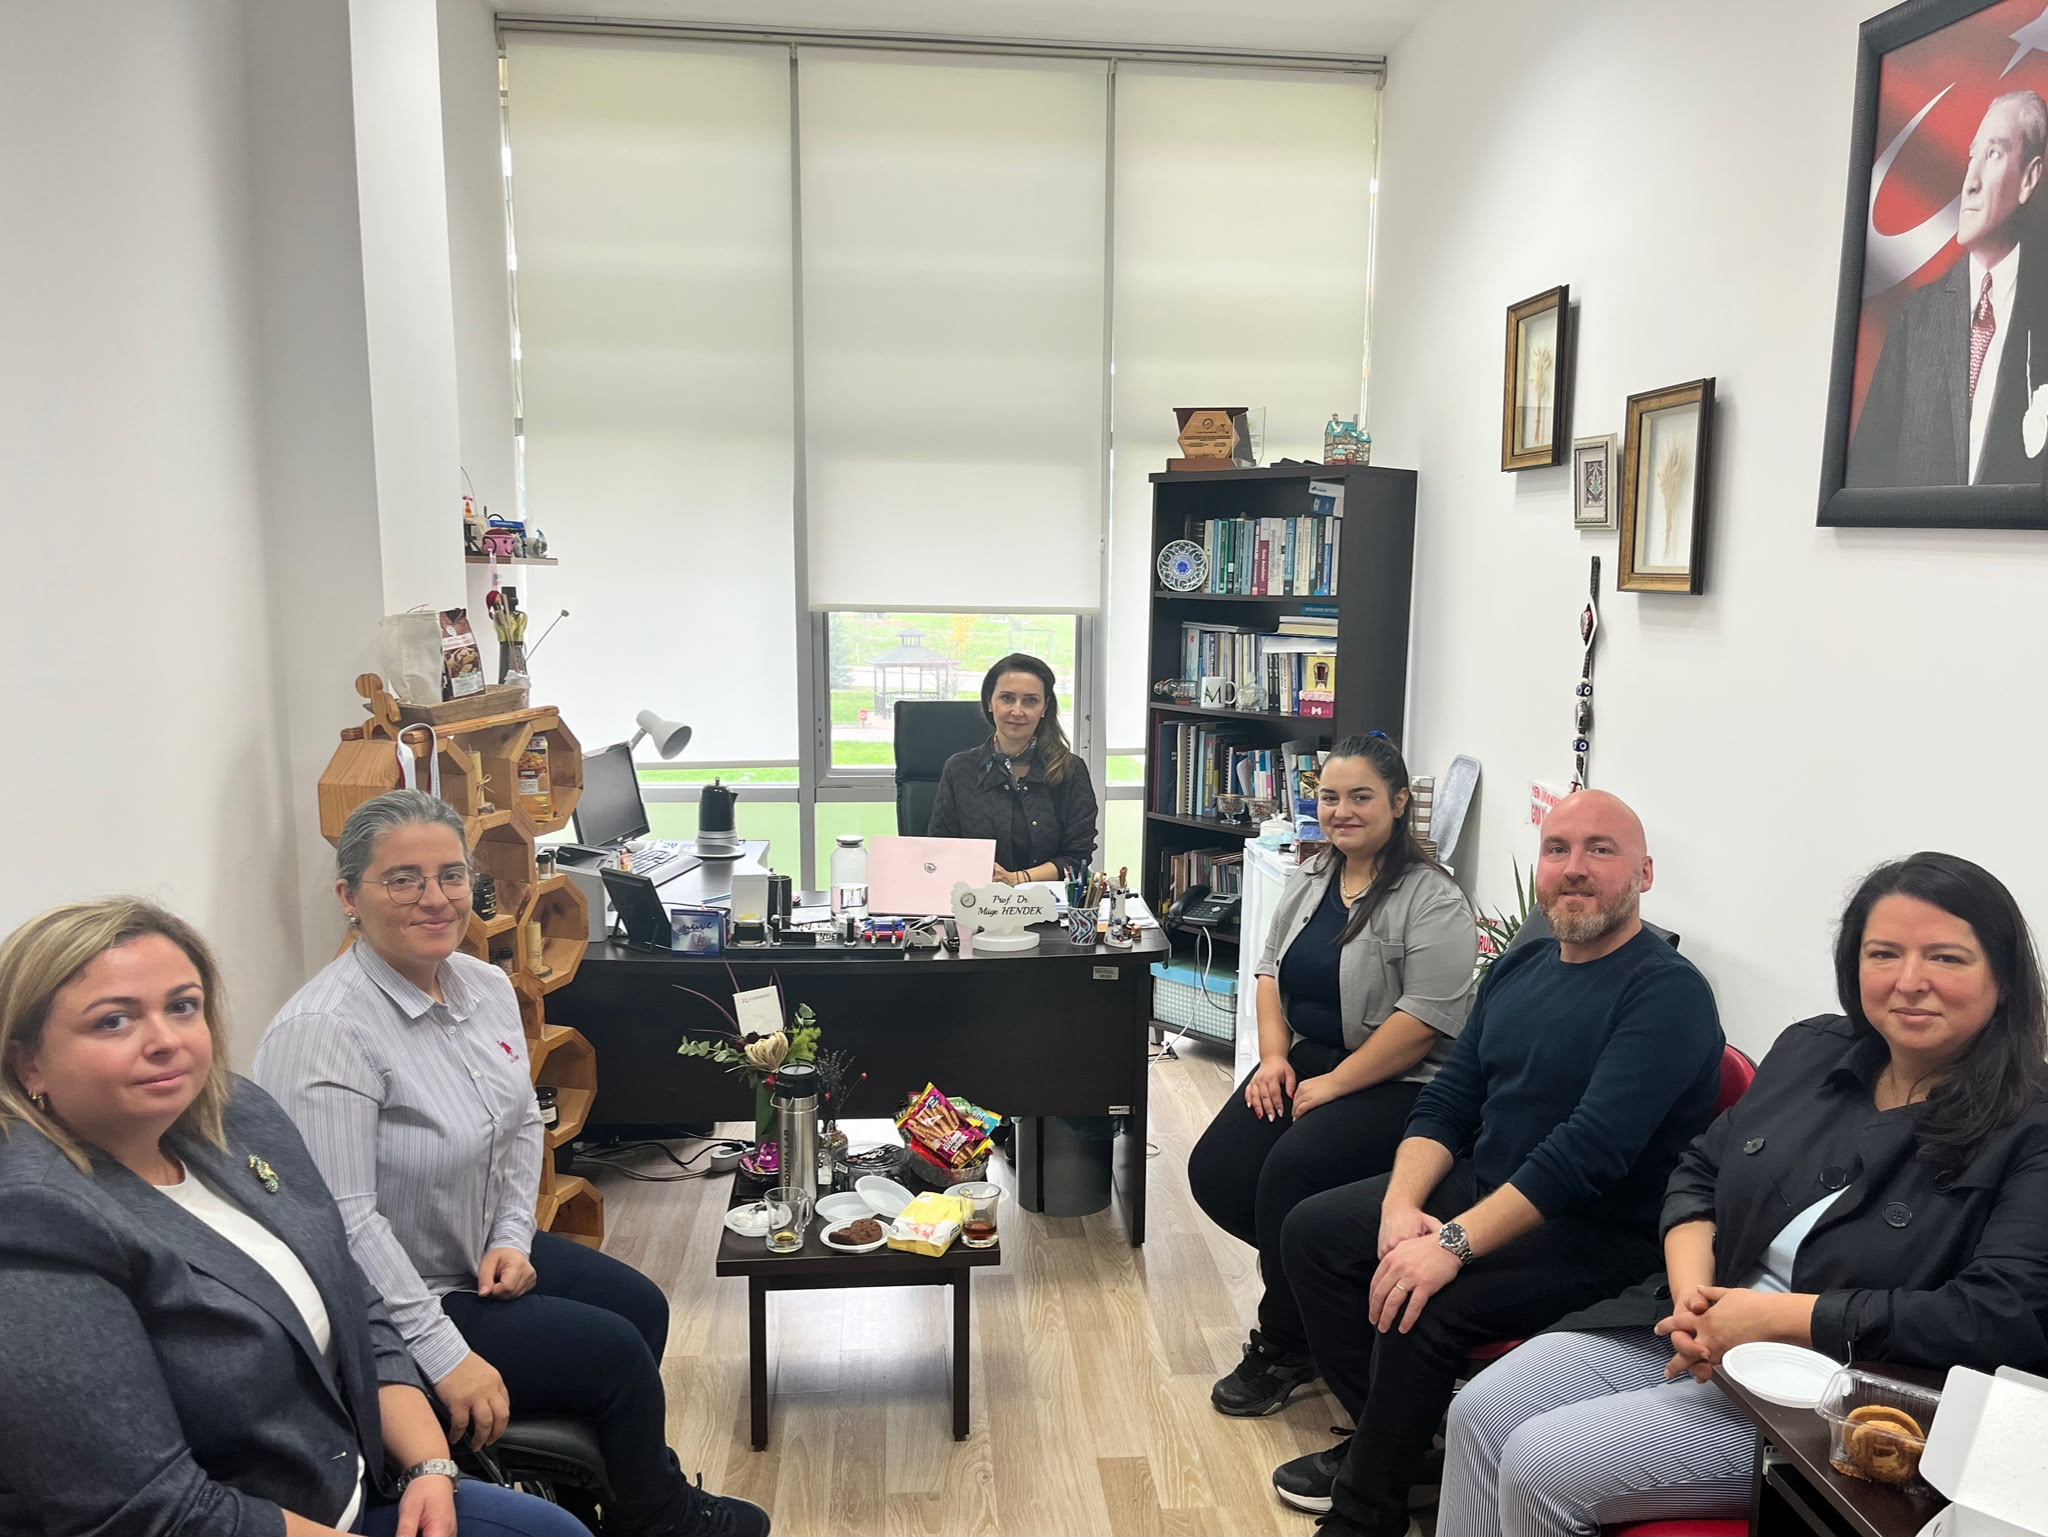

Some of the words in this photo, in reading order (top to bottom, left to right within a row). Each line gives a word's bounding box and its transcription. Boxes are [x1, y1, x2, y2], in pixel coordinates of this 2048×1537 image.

[1203, 685, 1222, 704] M
[977, 906, 998, 917] Müge
[1001, 906, 1043, 915] HENDEK
[783, 1129, 791, 1149] LAB
